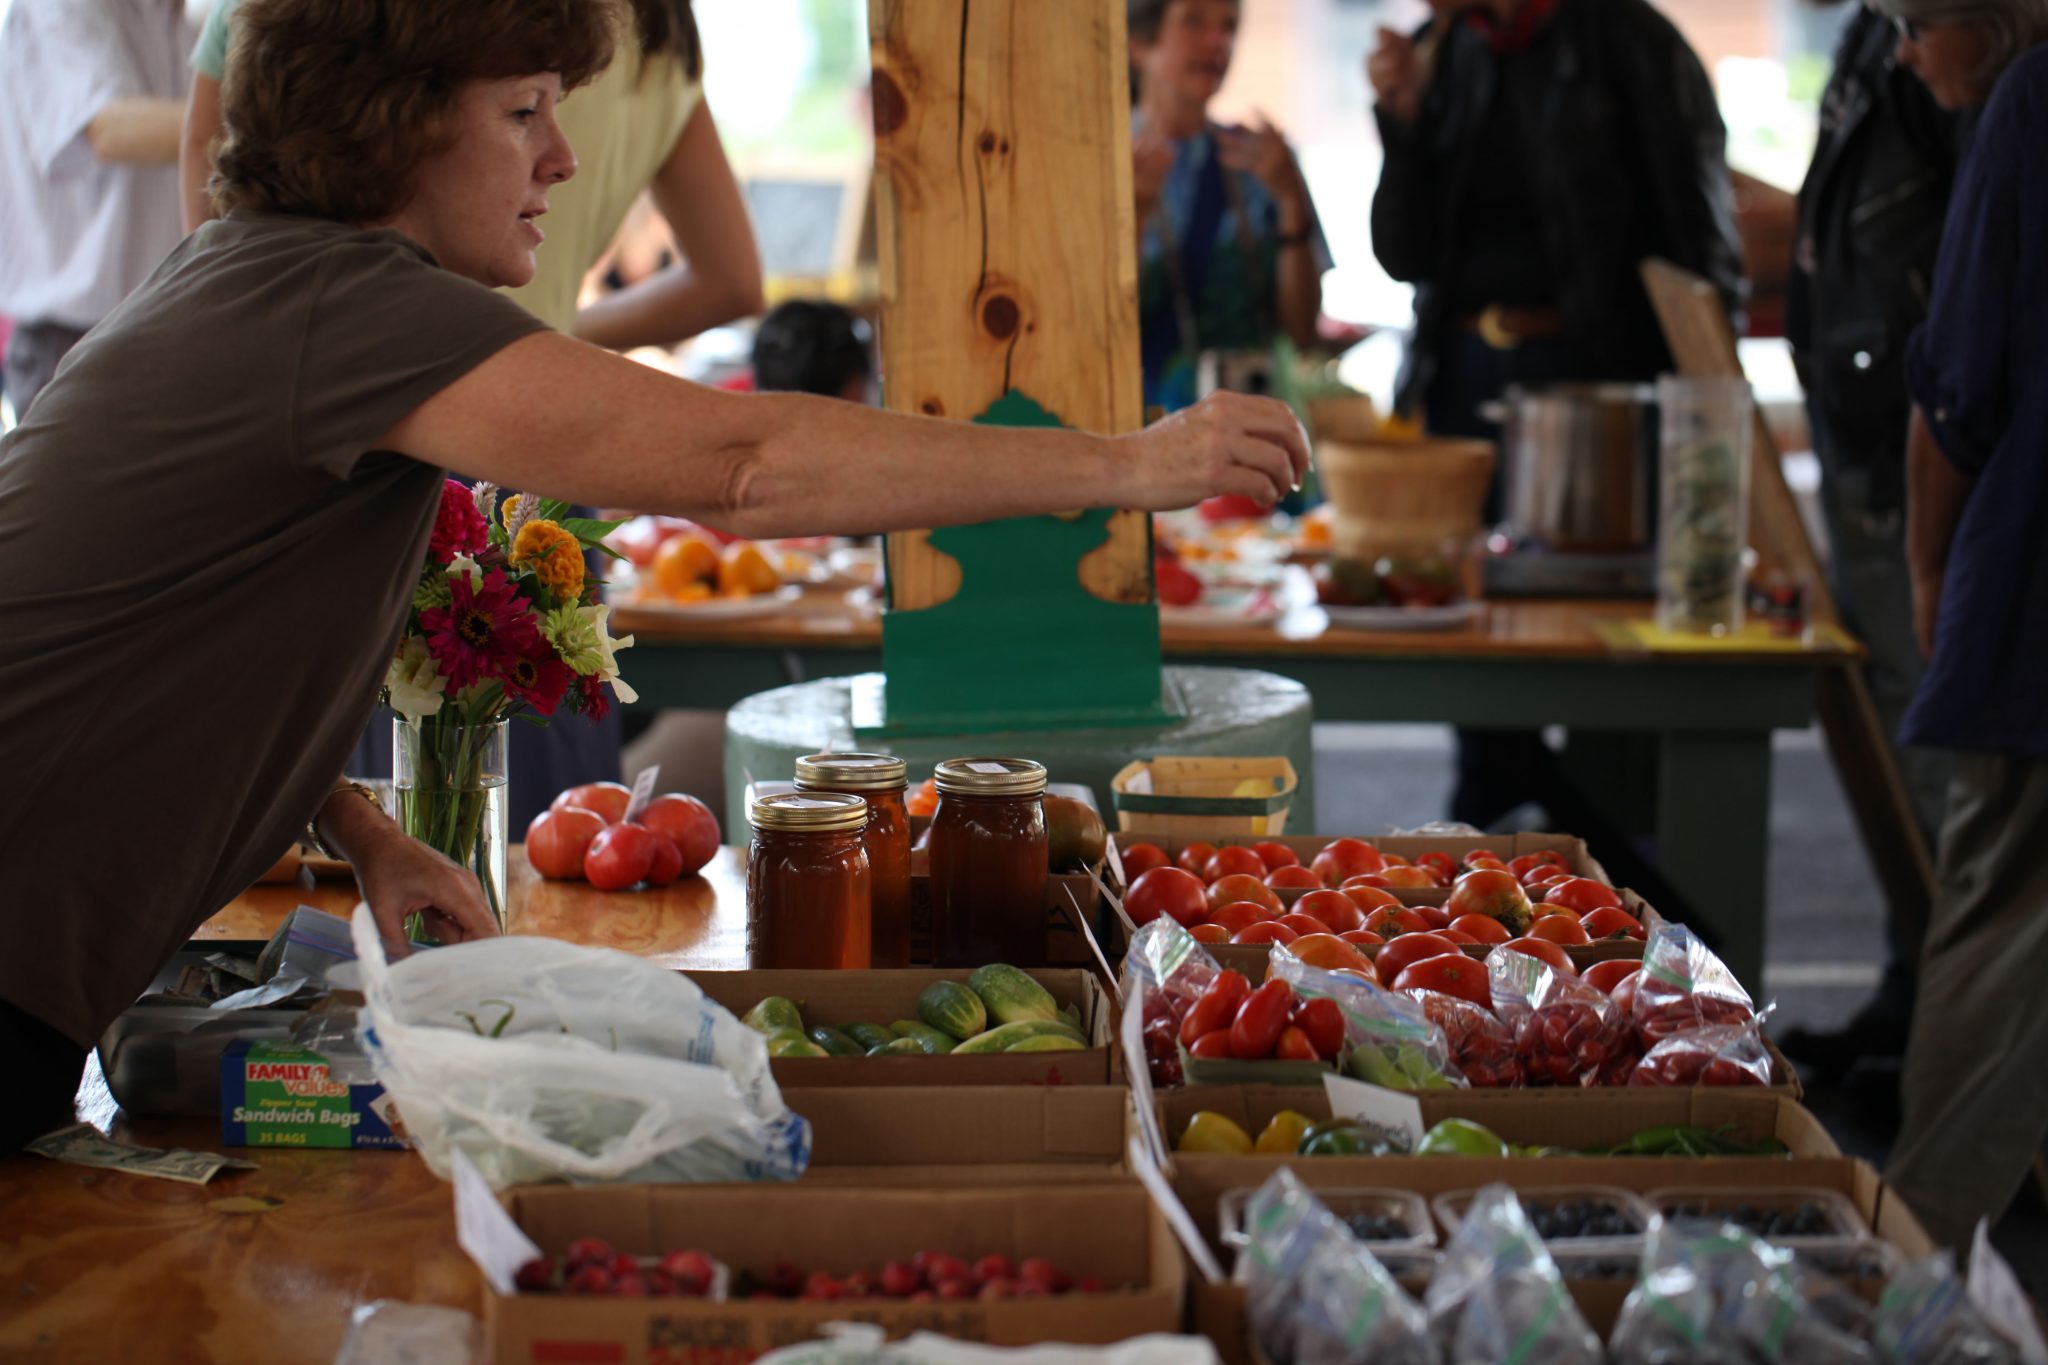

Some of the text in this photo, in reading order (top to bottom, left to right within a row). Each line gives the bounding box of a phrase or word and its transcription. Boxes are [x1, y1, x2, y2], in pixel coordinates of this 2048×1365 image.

[248, 1063, 311, 1081] FAMILY
[233, 1107, 361, 1128] Sandwich Bags
[259, 1132, 306, 1144] 35 BAGS
